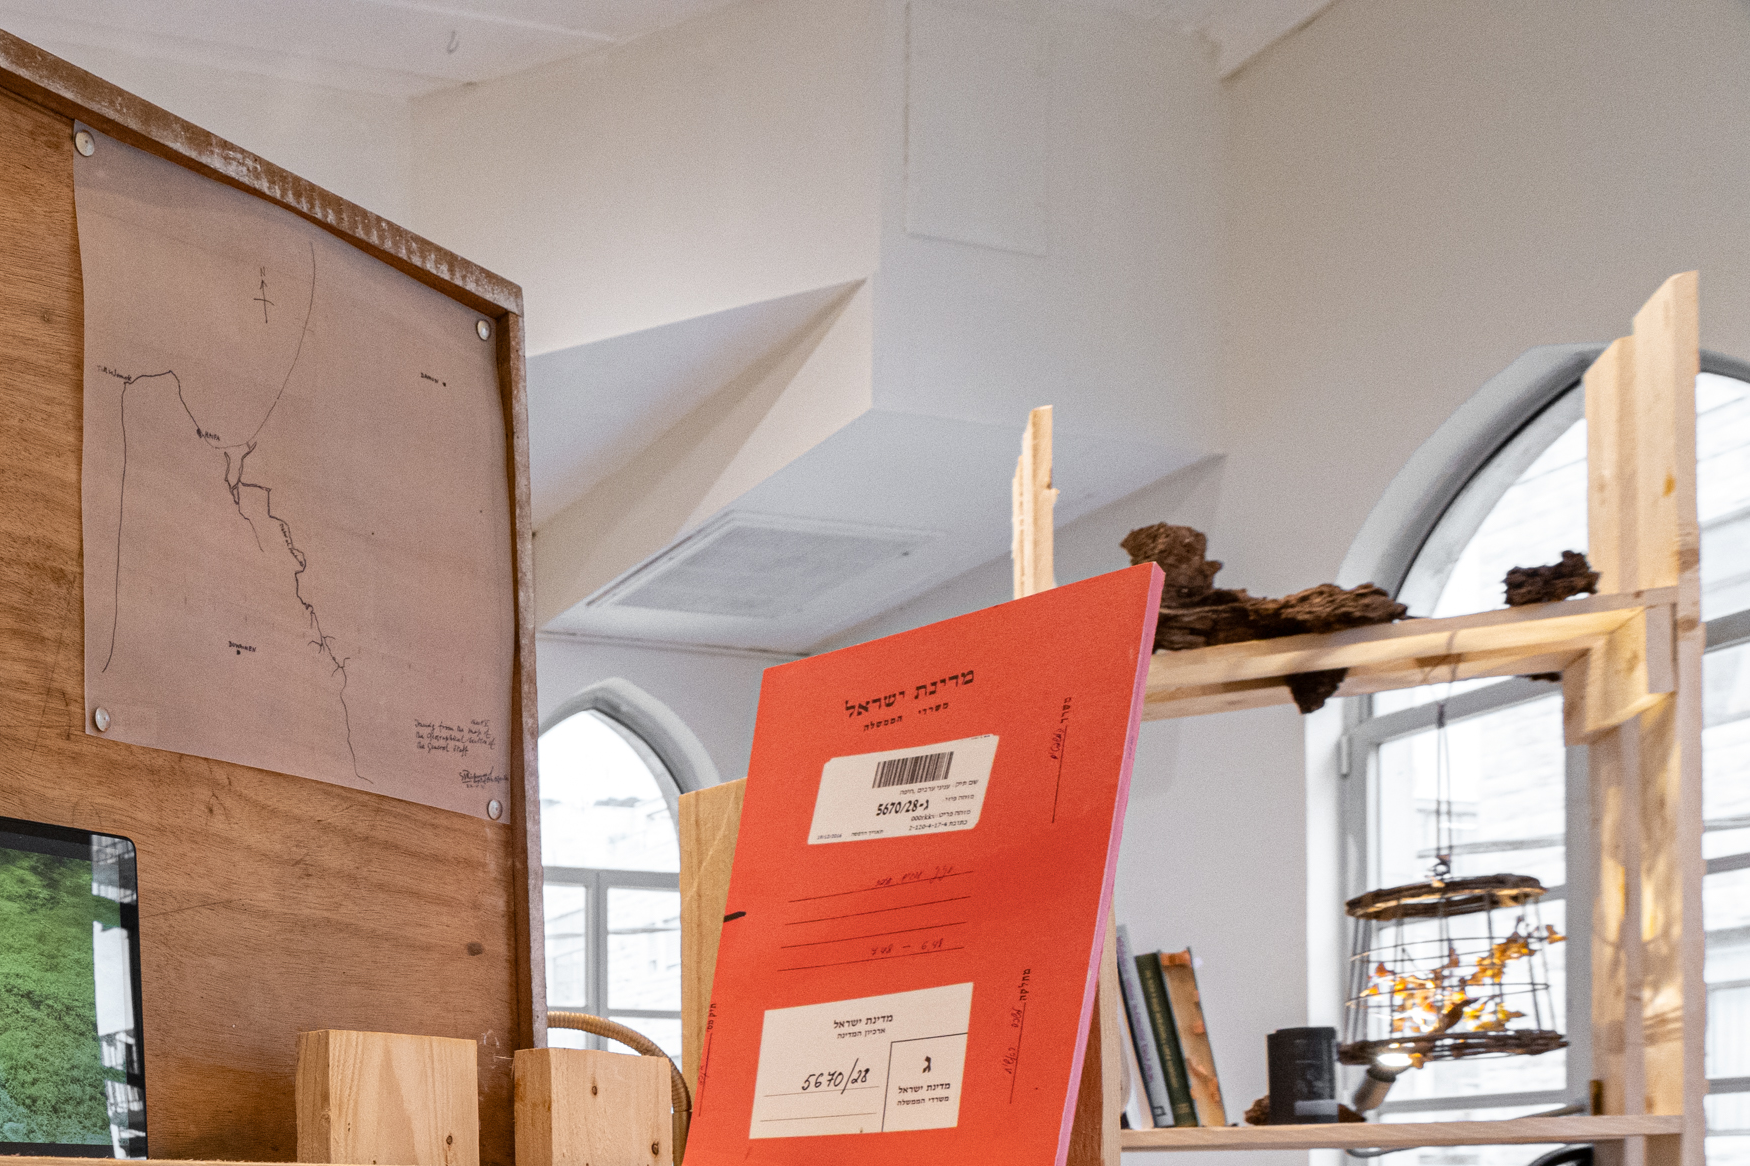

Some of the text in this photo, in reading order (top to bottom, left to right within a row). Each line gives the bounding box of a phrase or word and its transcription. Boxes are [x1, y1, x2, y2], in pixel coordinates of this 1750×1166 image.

[845, 670, 974, 718] מדינת ישראל
[863, 715, 903, 732] הממשלה
[1018, 968, 1031, 1001] מחלקה
[833, 1014, 894, 1029] מדינת ישראל
[837, 1027, 886, 1040] ארכיון המדינה
[921, 1055, 932, 1074] ג
[801, 1057, 871, 1095] 5670/28
[898, 1082, 951, 1094] מדינת ישראל
[897, 1095, 950, 1106] משרדי הממשלה
